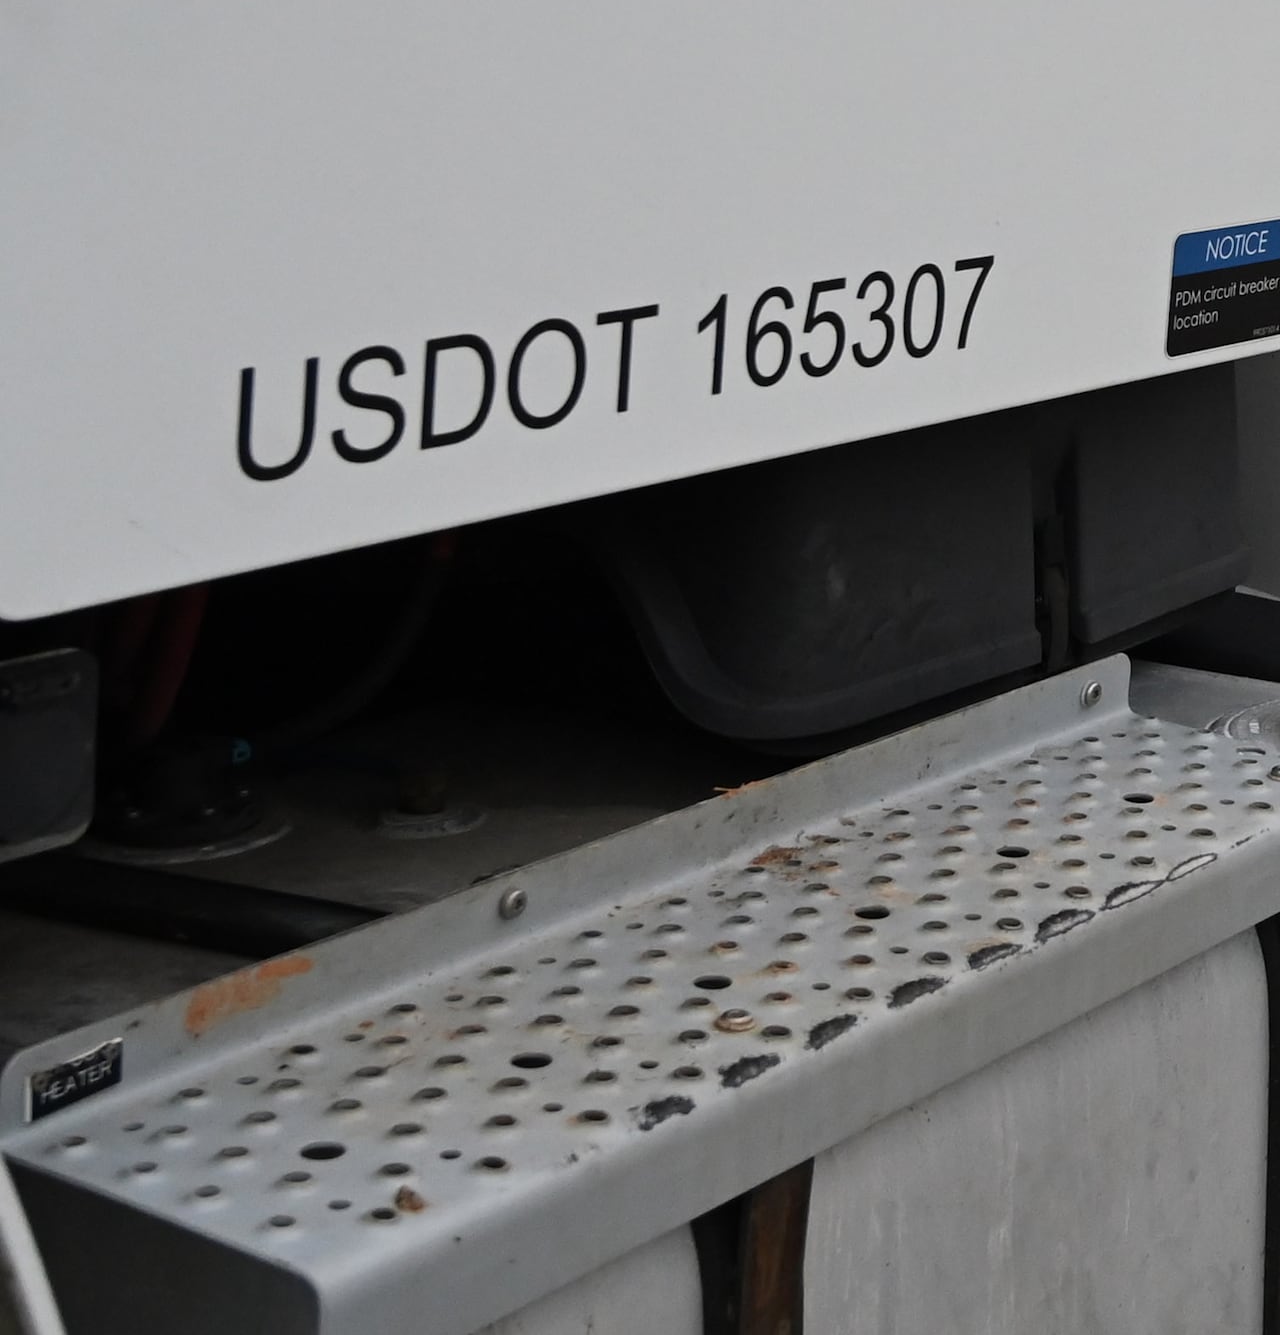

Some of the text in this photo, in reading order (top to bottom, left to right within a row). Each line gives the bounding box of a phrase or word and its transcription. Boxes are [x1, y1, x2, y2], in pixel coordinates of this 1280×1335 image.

[1205, 230, 1270, 262] NOTICE
[1175, 276, 1280, 307] PDM circuit breaker
[1173, 309, 1219, 331] location
[235, 254, 996, 483] USDOT 165307
